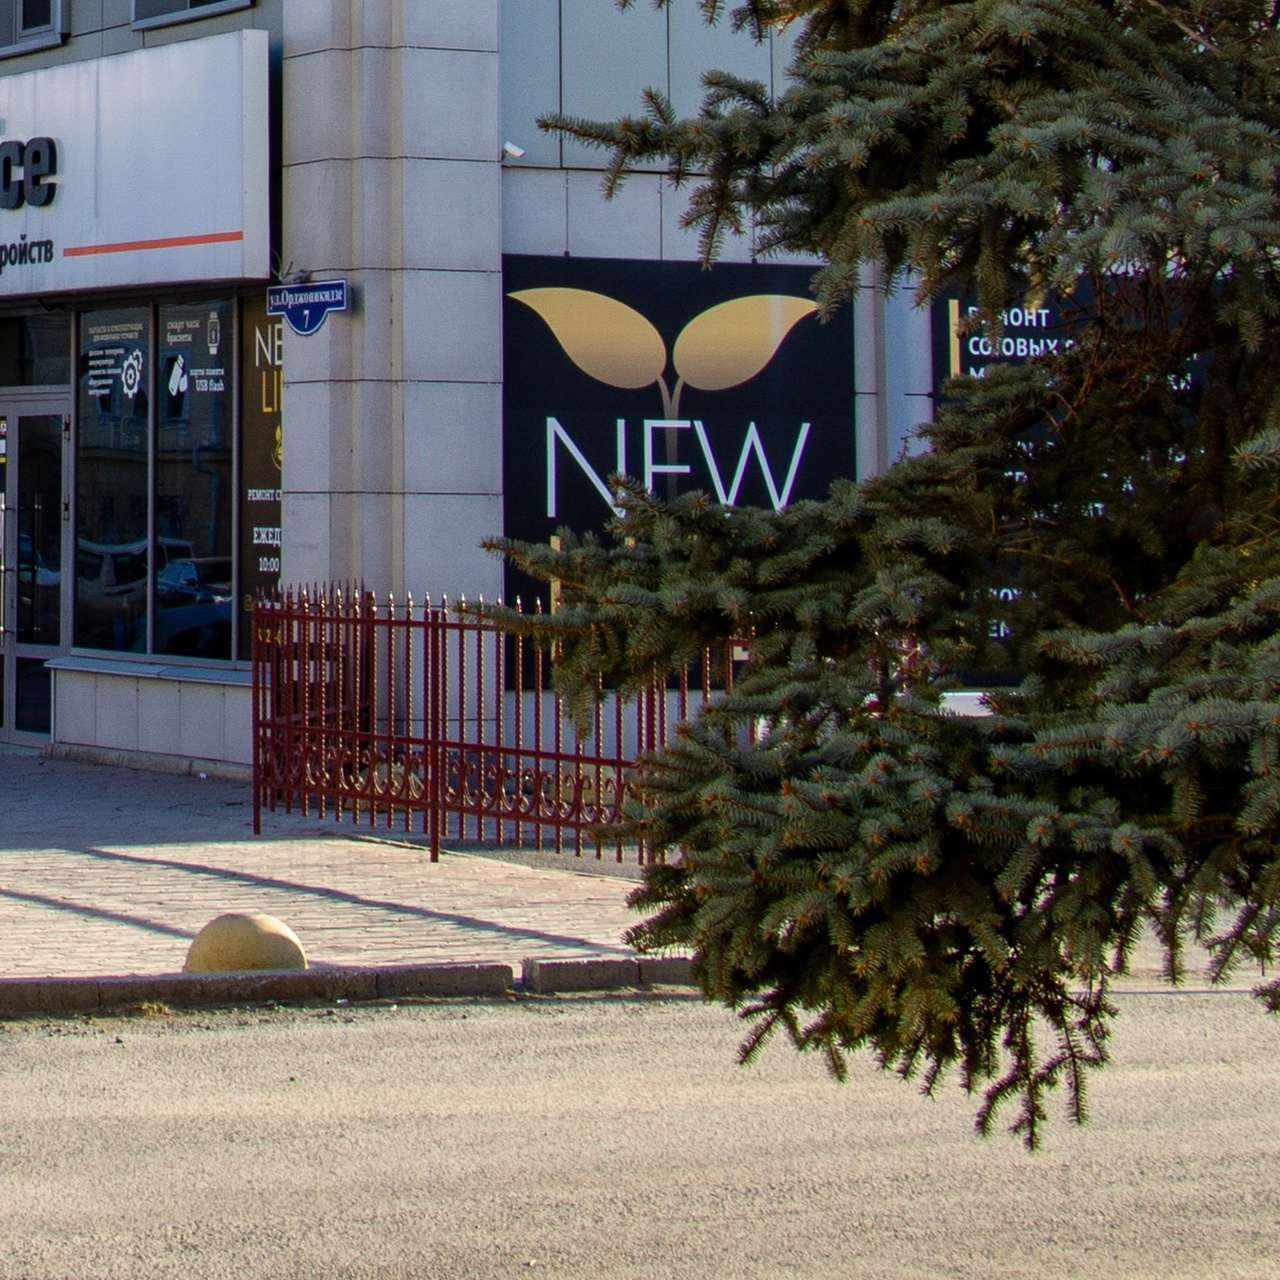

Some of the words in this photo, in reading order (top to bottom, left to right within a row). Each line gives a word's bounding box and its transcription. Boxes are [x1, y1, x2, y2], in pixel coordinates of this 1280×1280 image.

[302, 309, 311, 329] 7
[968, 336, 1059, 357] СООВЫХ
[546, 416, 811, 519] NEW
[247, 489, 274, 501] РЕМОНТ
[258, 557, 280, 572] 10:00
